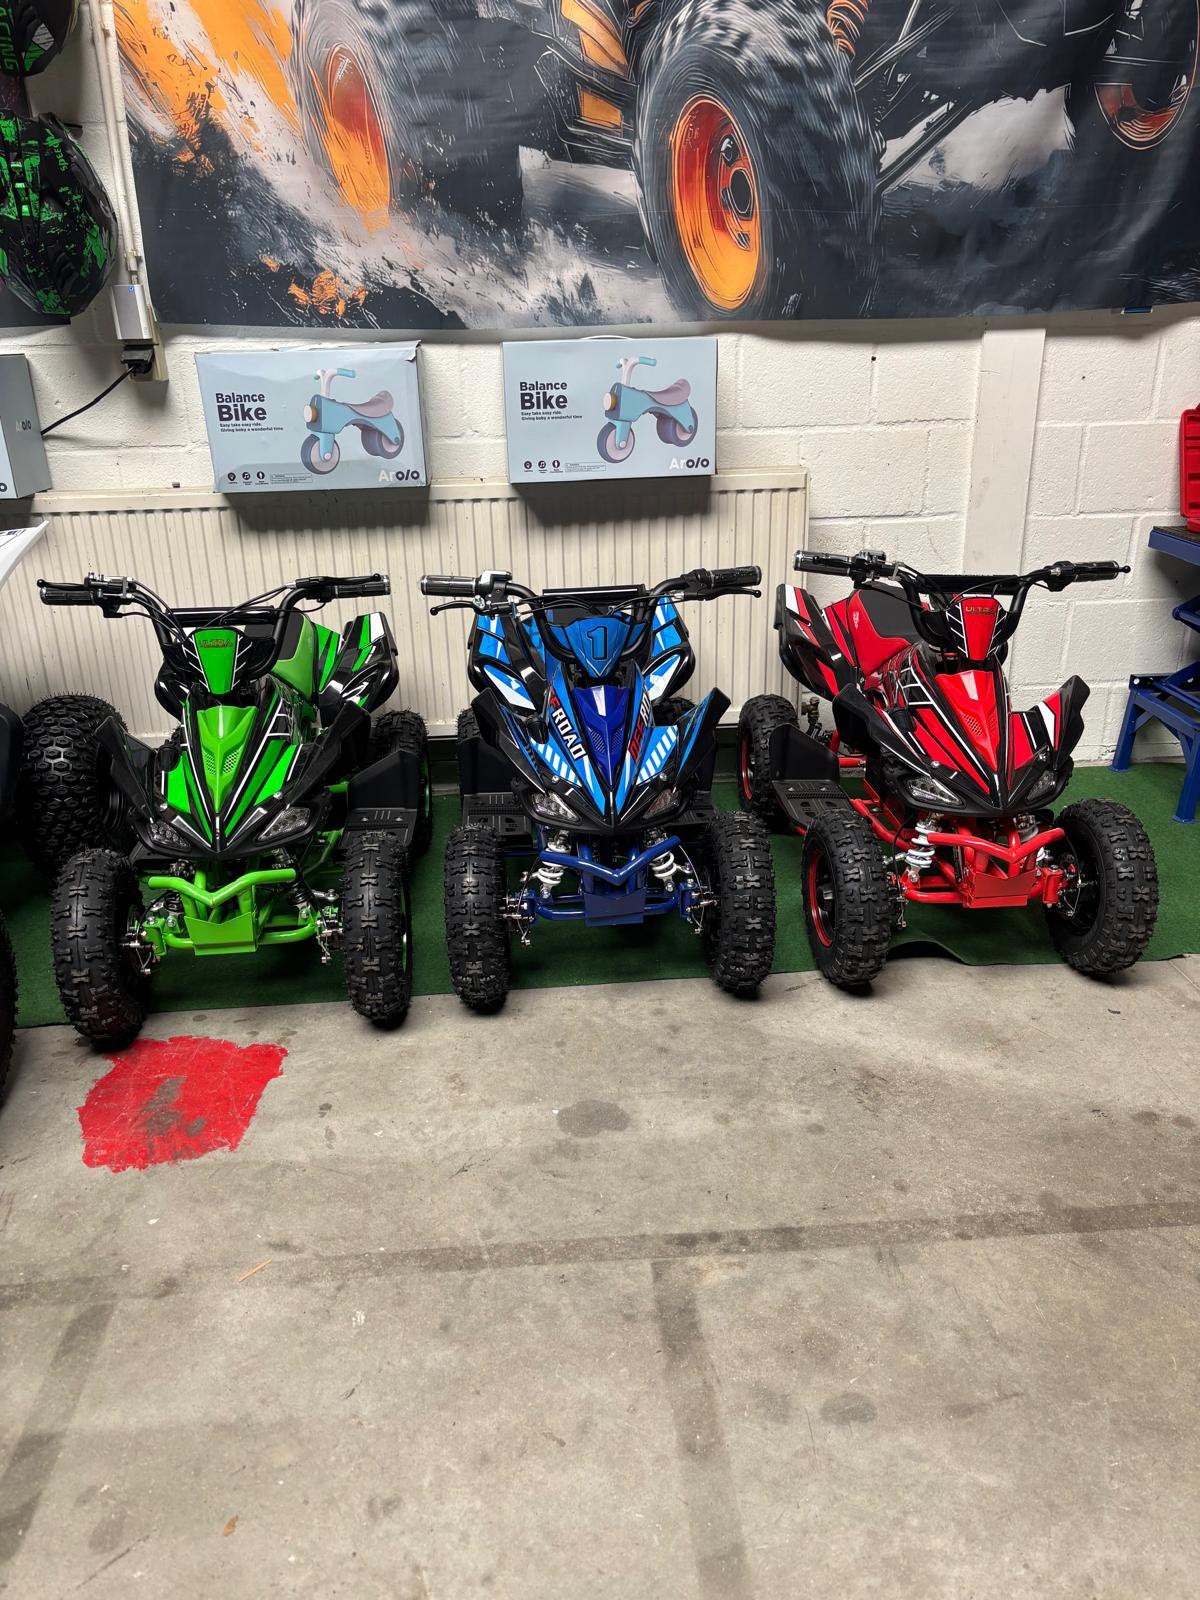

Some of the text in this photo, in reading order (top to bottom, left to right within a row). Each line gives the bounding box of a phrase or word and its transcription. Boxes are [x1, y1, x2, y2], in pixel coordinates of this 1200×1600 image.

[520, 381, 567, 391] Balance
[215, 392, 265, 403] Balance
[520, 391, 568, 410] Bike
[217, 404, 267, 421] Bike
[586, 626, 608, 660] 1
[549, 686, 587, 760] FROAD
[628, 689, 651, 763] OFFRO
